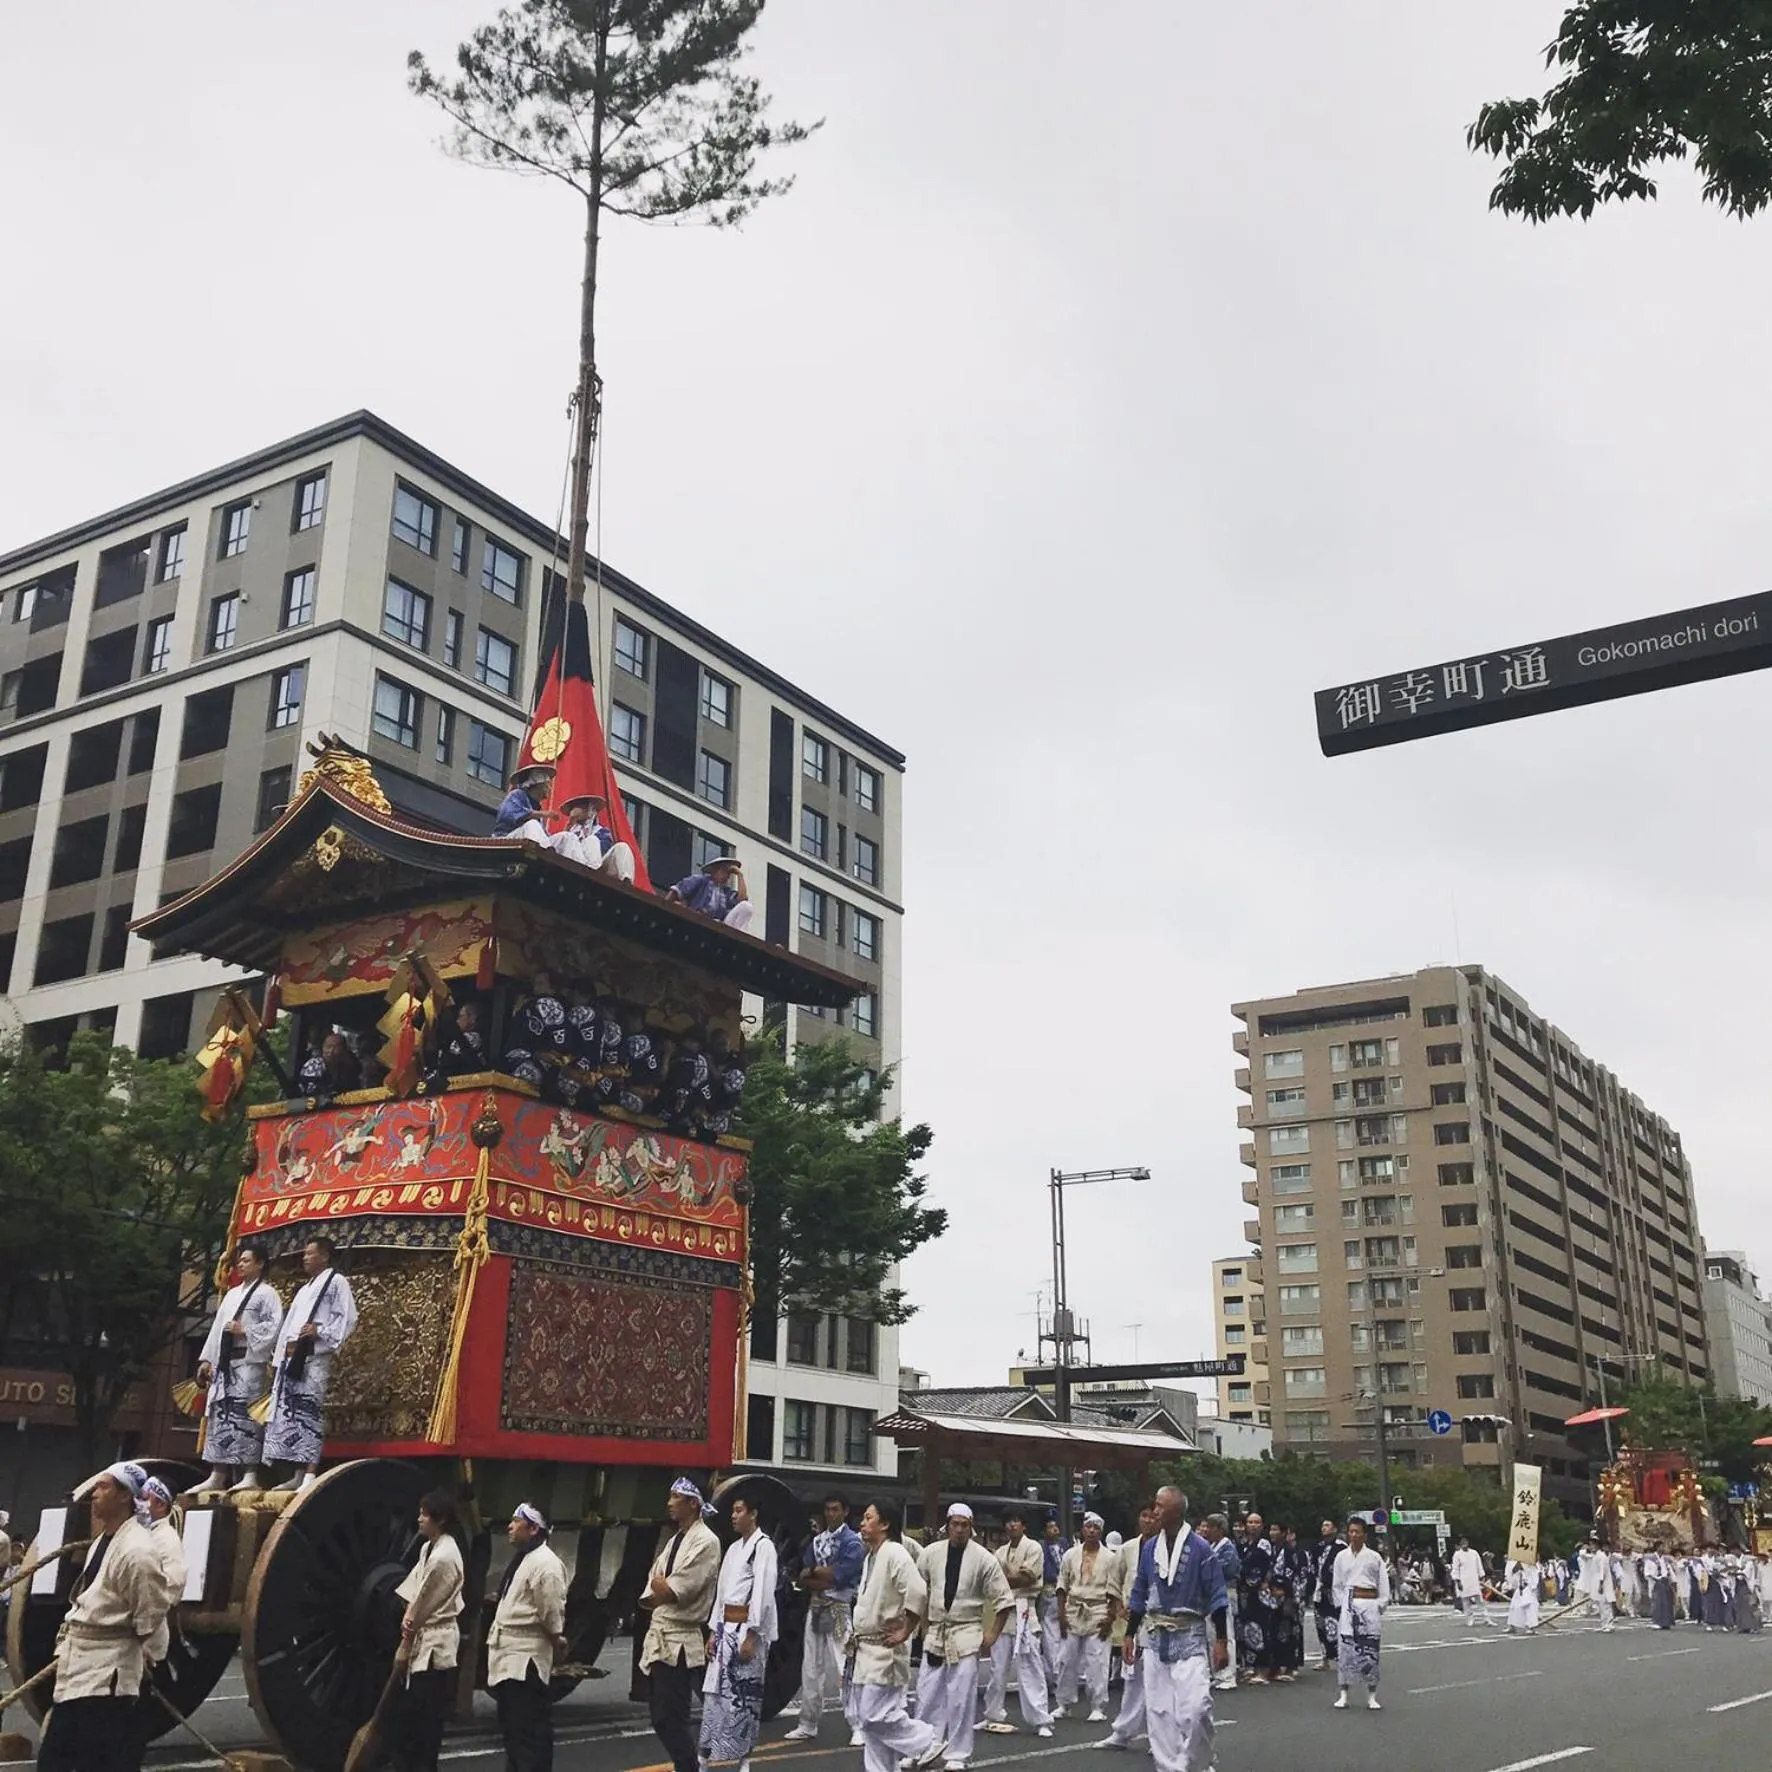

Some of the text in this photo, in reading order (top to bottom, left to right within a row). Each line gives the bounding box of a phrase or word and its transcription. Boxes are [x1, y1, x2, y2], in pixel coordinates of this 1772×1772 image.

[1577, 611, 1759, 666] Gokomachi dori
[1335, 646, 1551, 729] 御幸町通
[1515, 1490, 1534, 1551] 鈴鹿山
